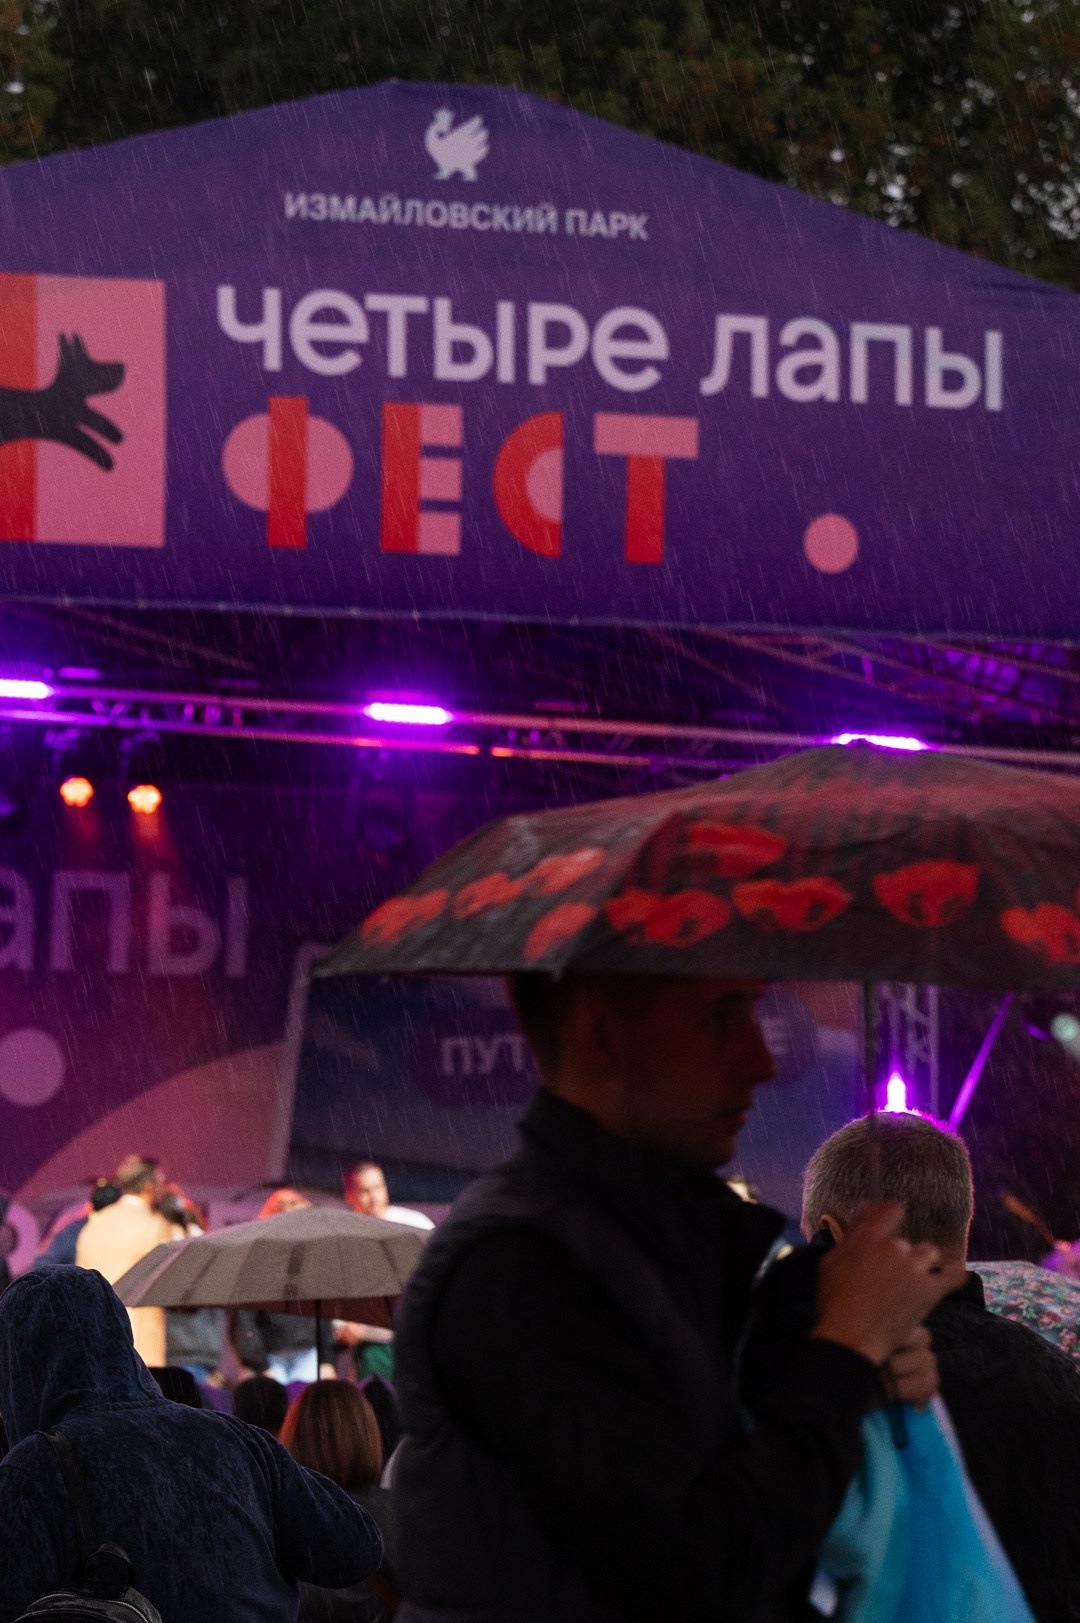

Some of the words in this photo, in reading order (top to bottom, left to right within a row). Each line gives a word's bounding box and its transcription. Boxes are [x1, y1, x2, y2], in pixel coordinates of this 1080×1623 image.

[284, 191, 558, 235] ИЗМАЙЛОВСКИЙ
[565, 208, 650, 241] ПАРК
[217, 284, 670, 392] четыре
[700, 314, 1003, 411] лапы
[222, 396, 699, 564] ФЕСТ
